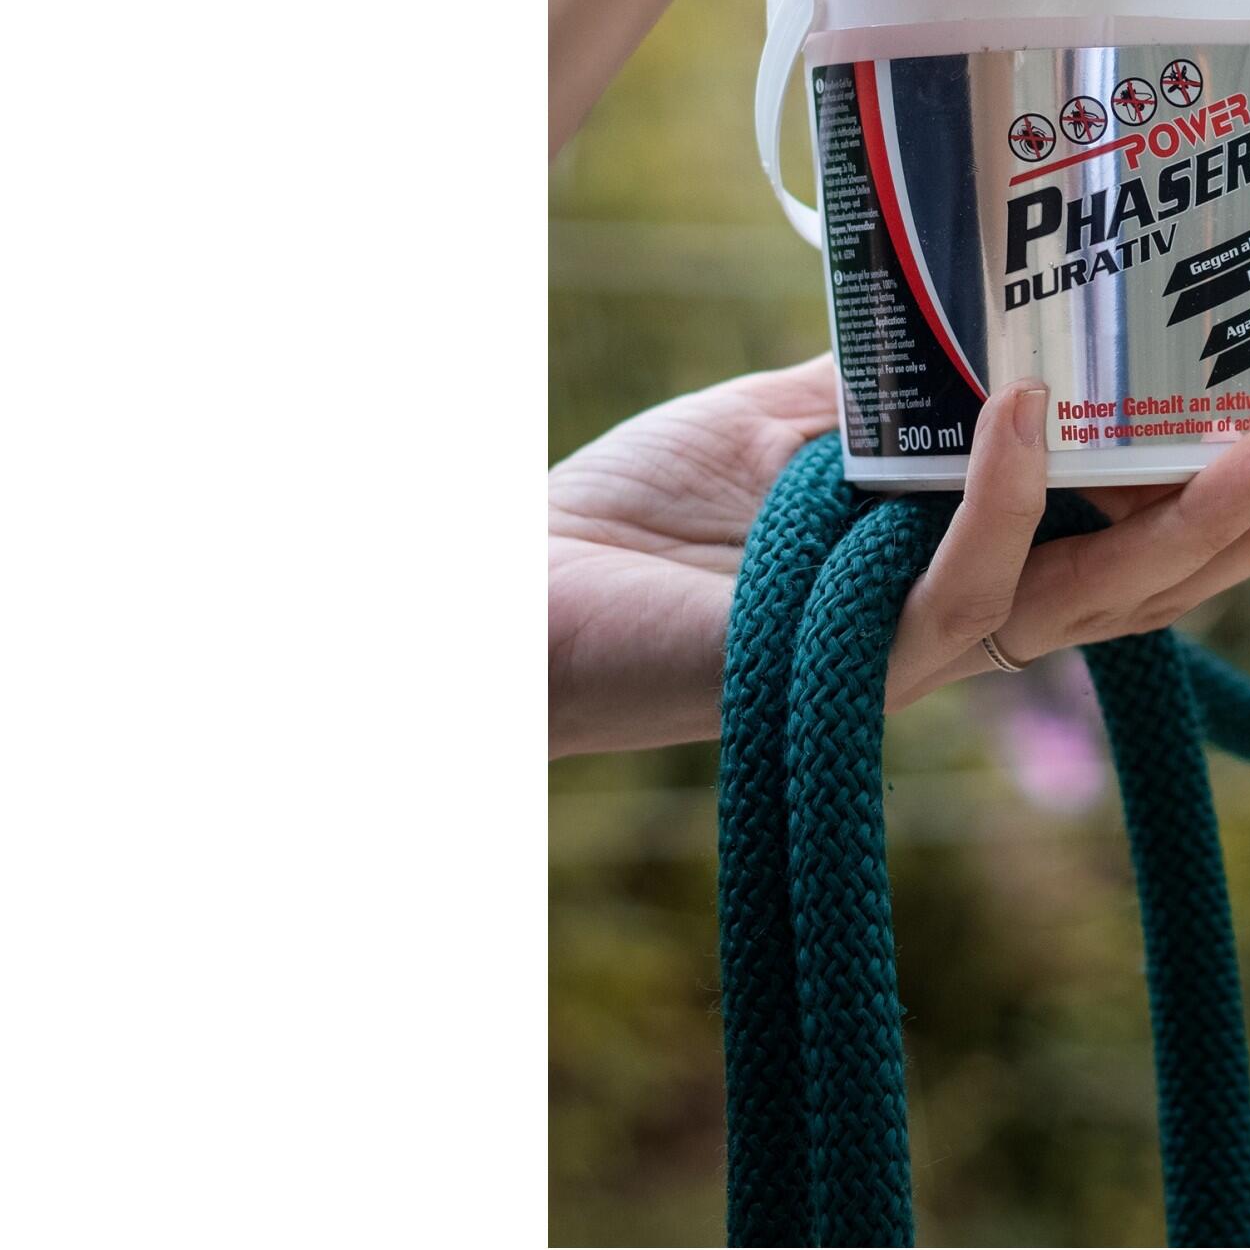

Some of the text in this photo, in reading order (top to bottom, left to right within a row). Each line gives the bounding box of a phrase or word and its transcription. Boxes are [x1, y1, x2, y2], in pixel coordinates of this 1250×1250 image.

[1004, 223, 1177, 312] DURATIV
[1190, 247, 1239, 275] Gegen
[905, 361, 918, 374] only
[1057, 400, 1117, 420] Hoher
[1122, 395, 1184, 417] Gehalt
[1189, 397, 1210, 413] an
[898, 422, 964, 451] 500 ml
[1061, 424, 1099, 444] High
[1104, 417, 1213, 440] concentration
[1217, 416, 1232, 432] of
